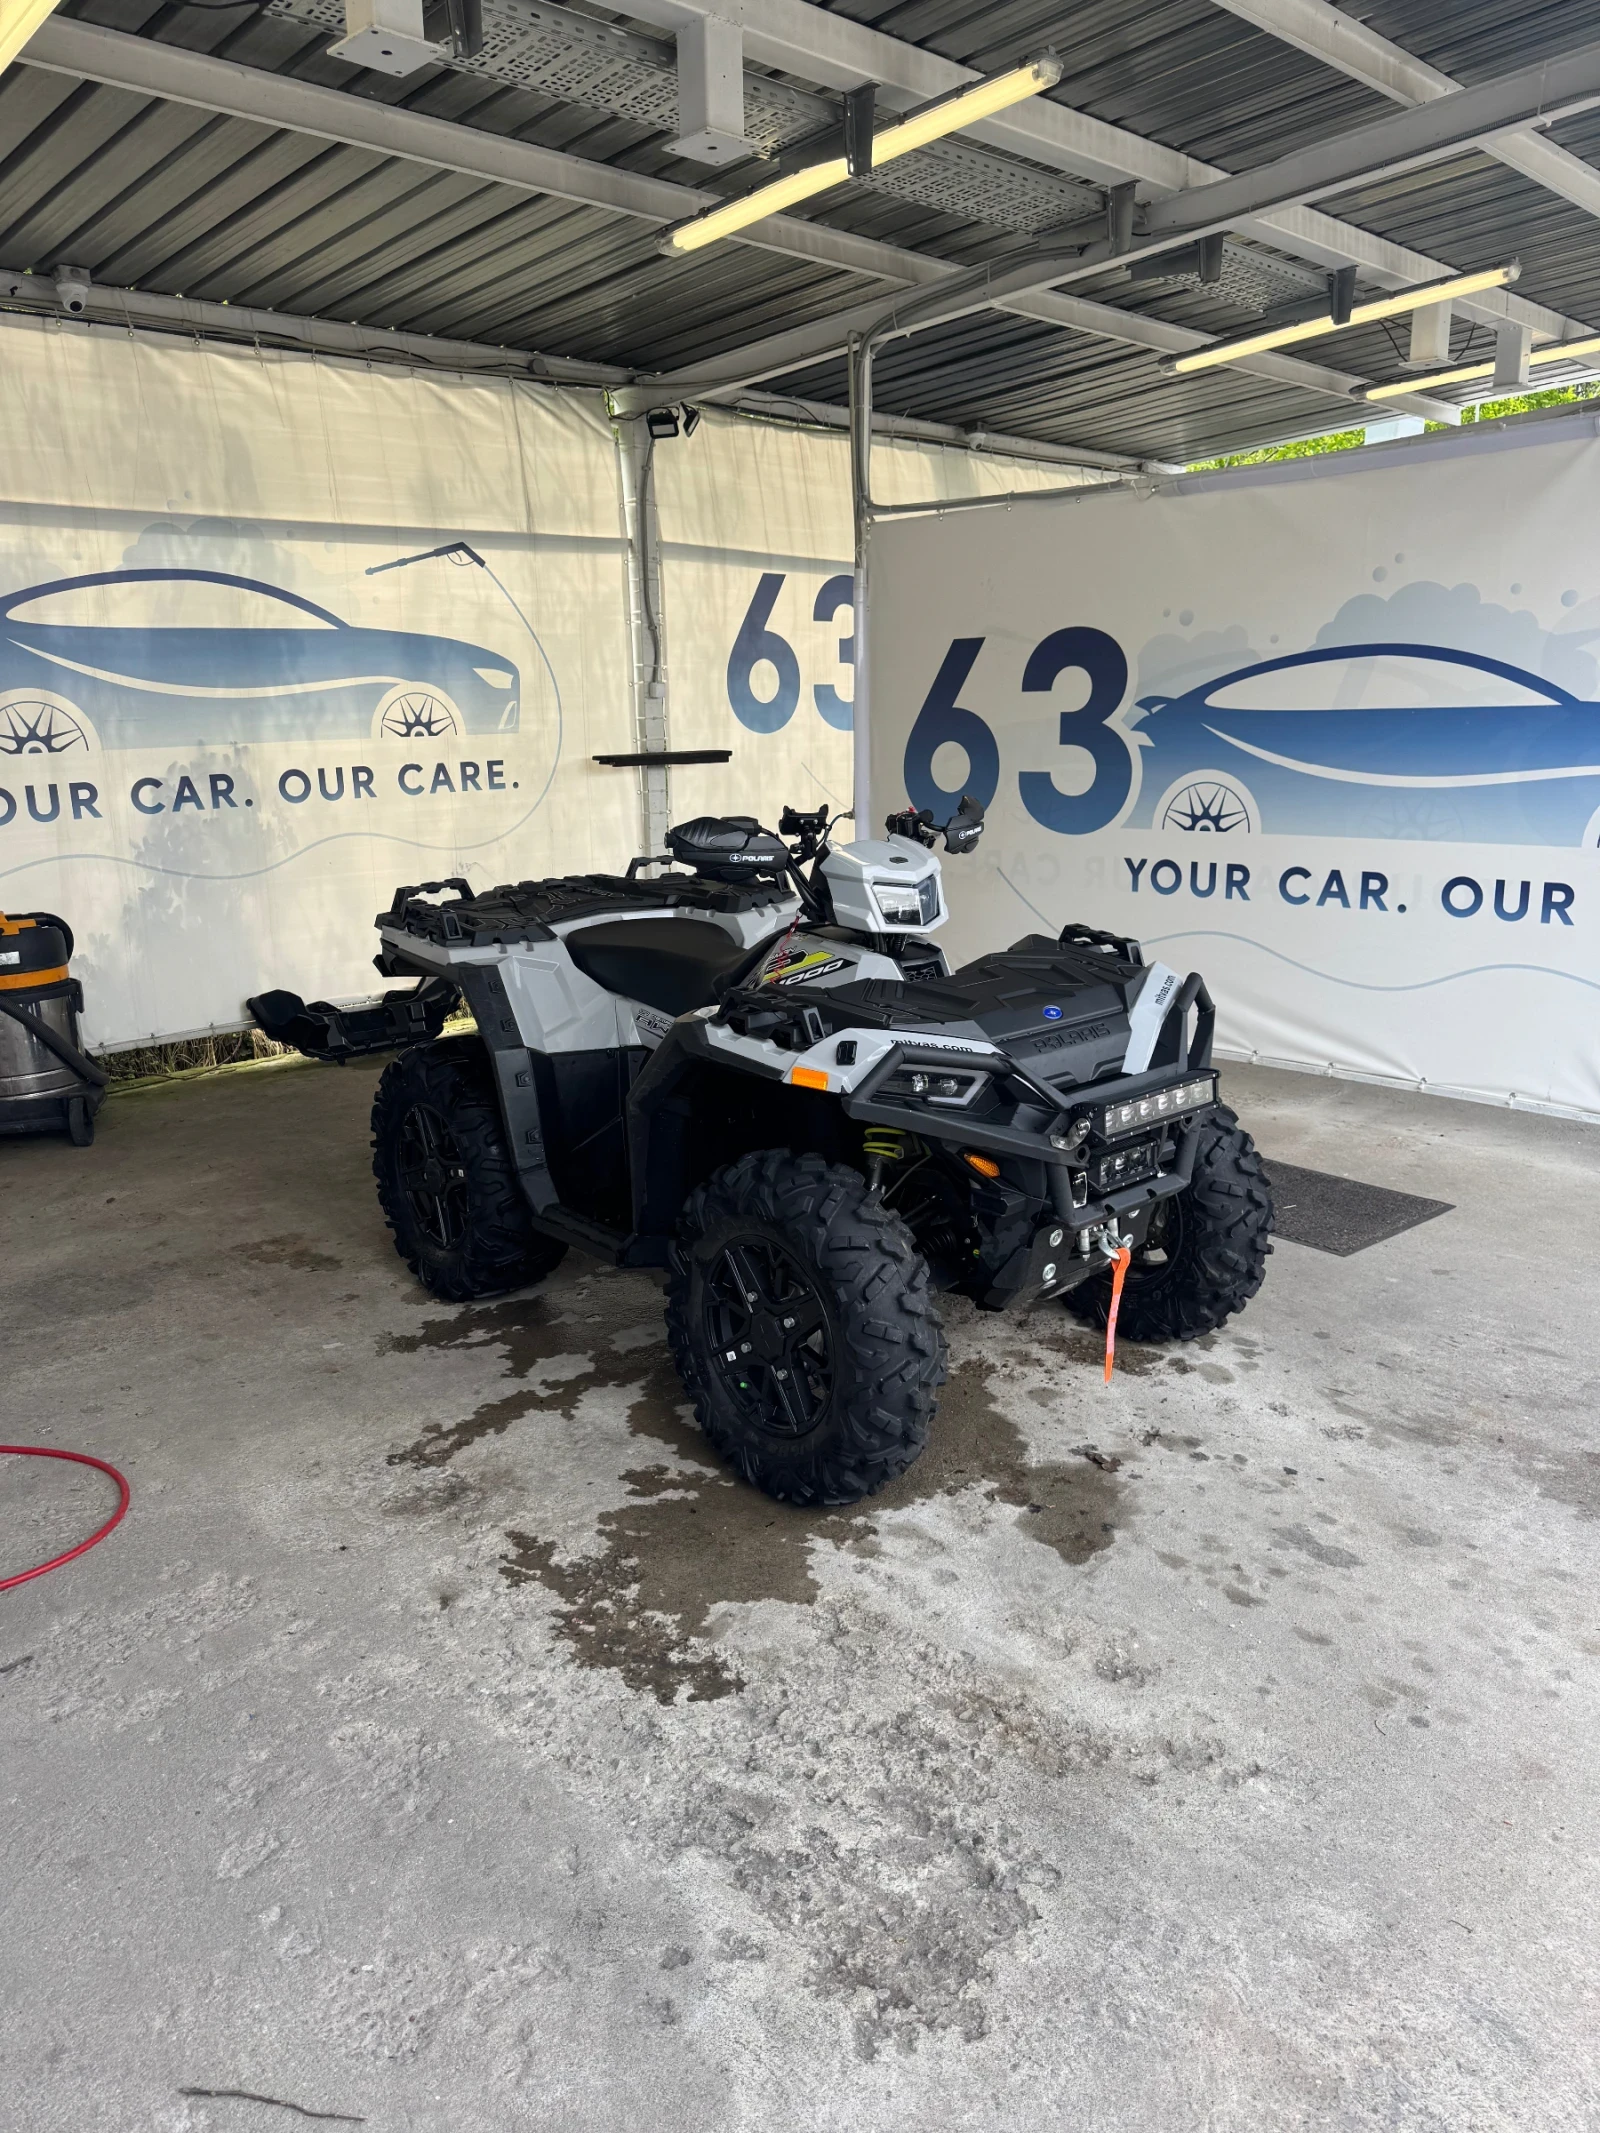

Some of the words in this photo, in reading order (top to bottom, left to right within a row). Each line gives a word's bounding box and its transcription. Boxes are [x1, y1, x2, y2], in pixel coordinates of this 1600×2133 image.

[903, 626, 1133, 836] 63
[131, 773, 253, 815] CAR.
[279, 765, 377, 804] OUR
[398, 760, 519, 796] CARE.
[1123, 857, 1251, 902] YOUR
[1278, 866, 1407, 914] CAR.
[1441, 876, 1575, 926] OUR
[1032, 1022, 1112, 1053] POLARIS
